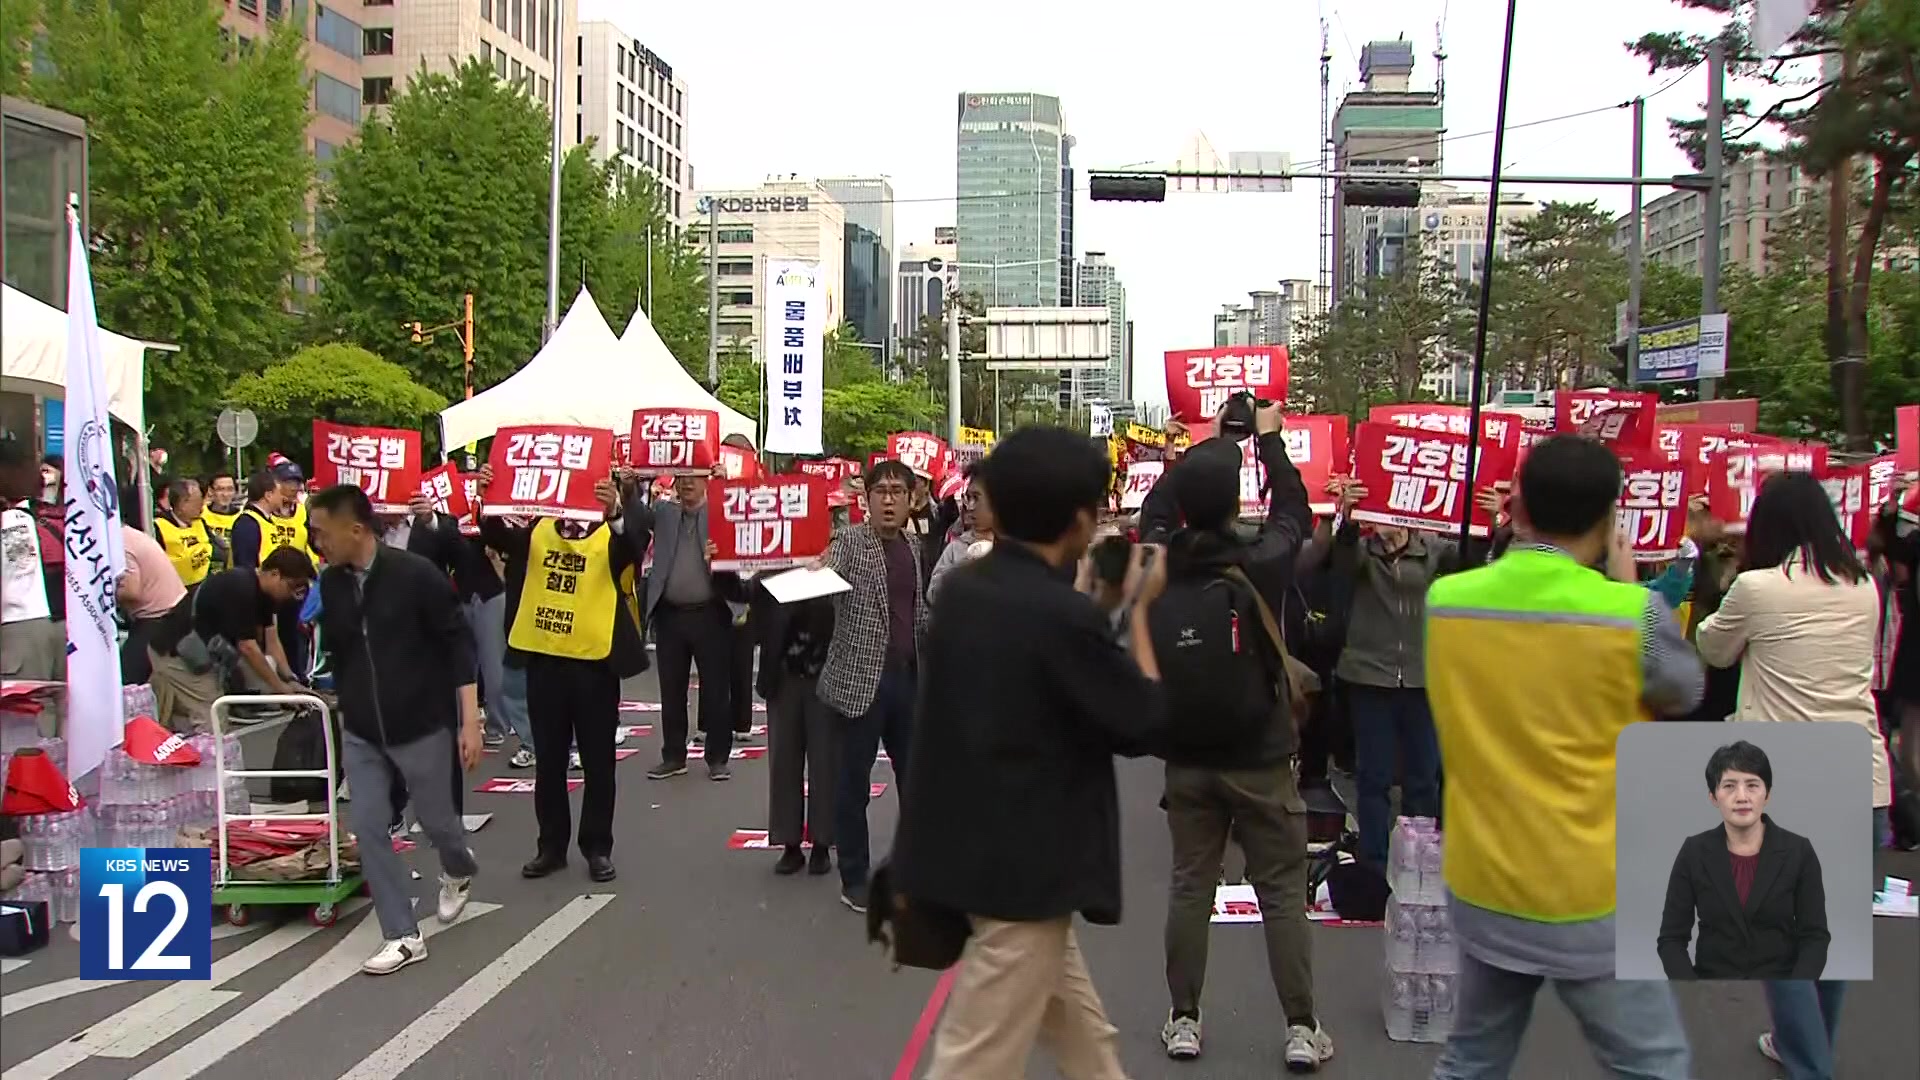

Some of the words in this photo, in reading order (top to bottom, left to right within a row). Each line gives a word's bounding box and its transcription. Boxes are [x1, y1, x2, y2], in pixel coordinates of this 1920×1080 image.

[1185, 354, 1271, 389] 간호법
[641, 412, 708, 441] 간호법
[327, 431, 406, 470] 간호법
[505, 431, 593, 471] 간호법
[648, 440, 693, 467] 폐기
[895, 436, 939, 459] 간호법
[1381, 434, 1483, 483] 간호법
[511, 465, 572, 504] 폐기
[722, 483, 809, 522] 간호법
[1386, 474, 1459, 517] 폐기
[735, 519, 793, 556] 폐기
[543, 549, 587, 573] 간호법
[545, 571, 577, 595] 철회
